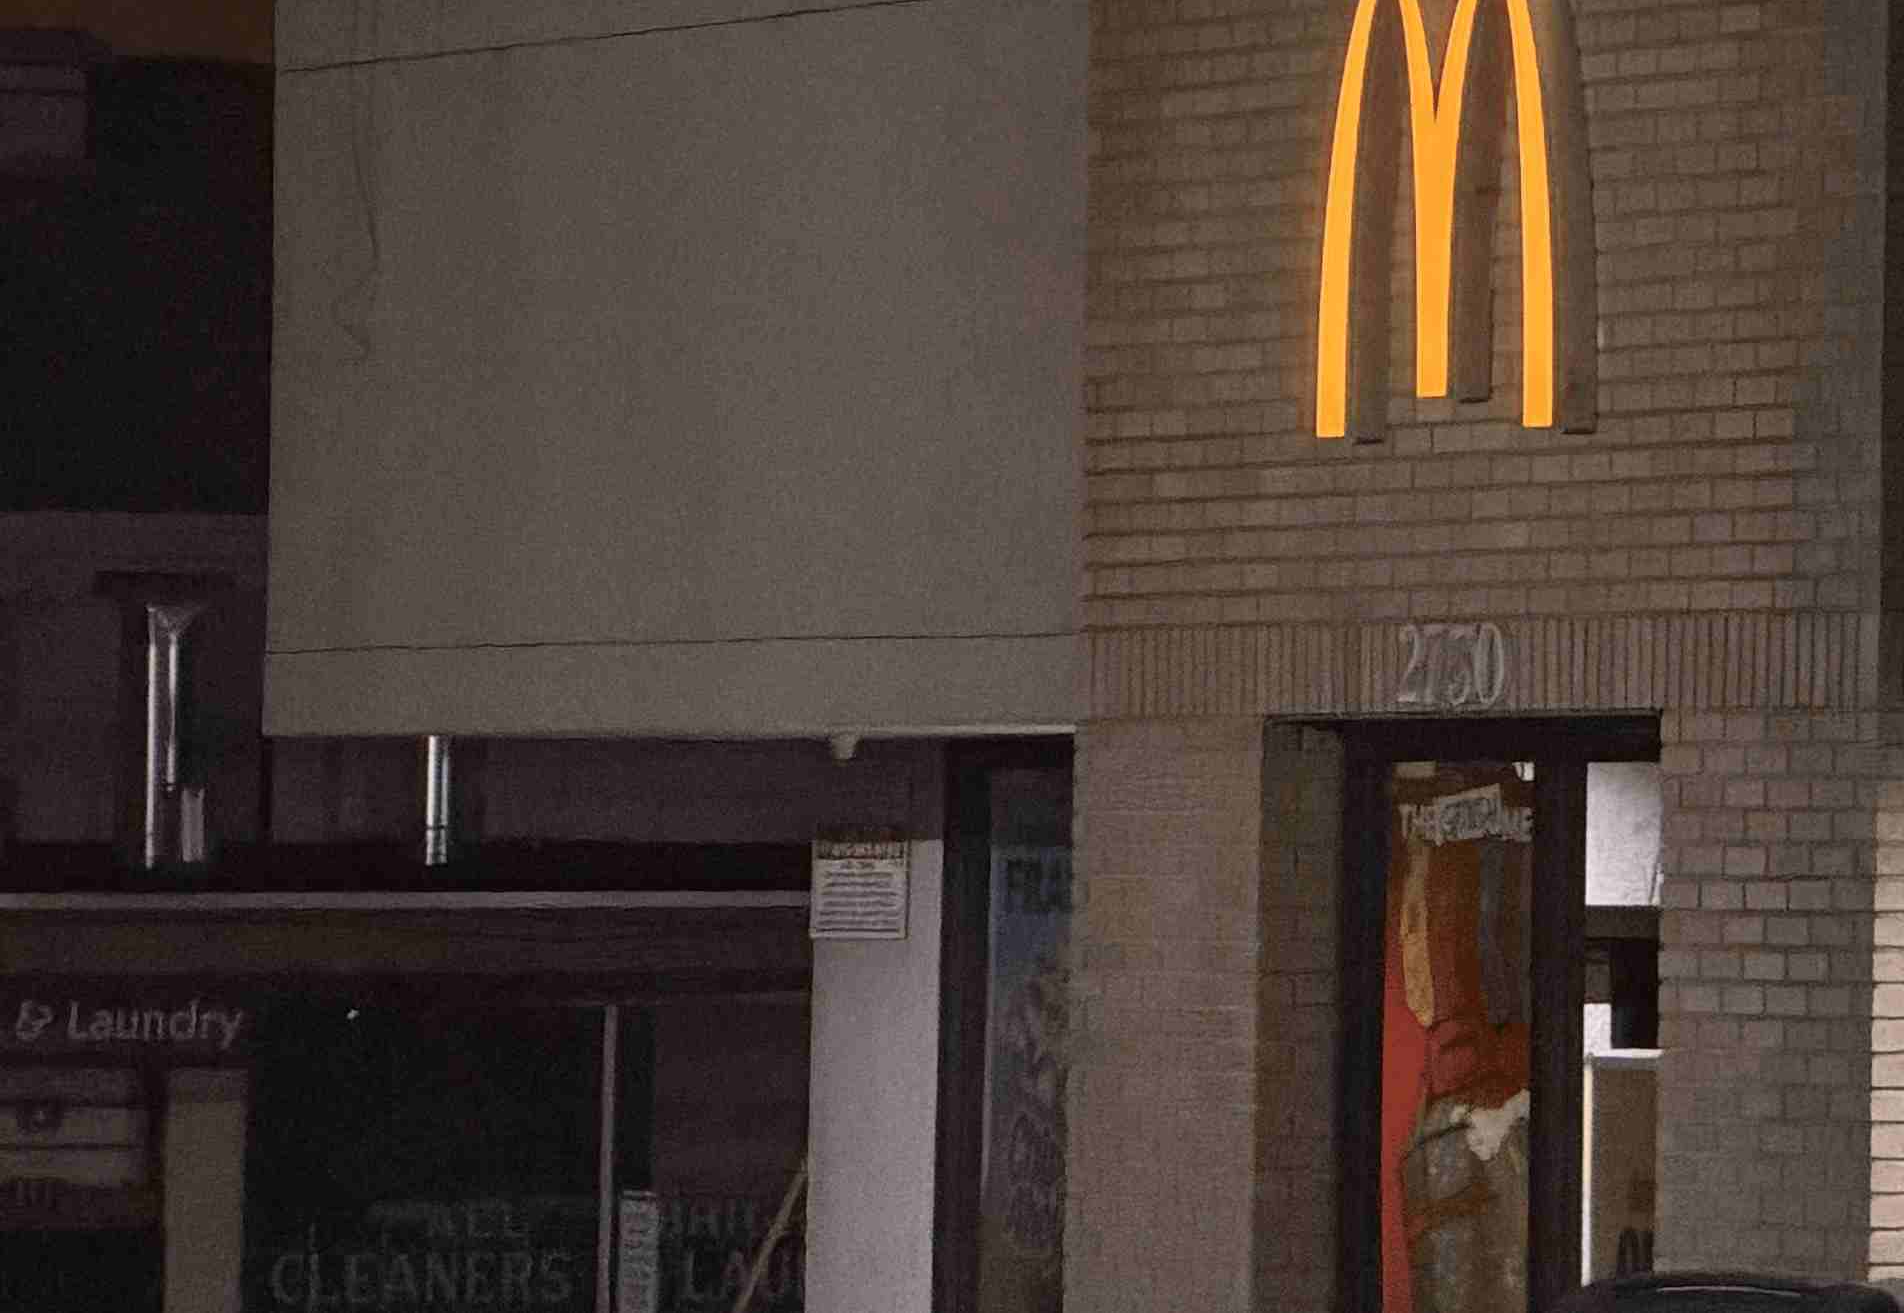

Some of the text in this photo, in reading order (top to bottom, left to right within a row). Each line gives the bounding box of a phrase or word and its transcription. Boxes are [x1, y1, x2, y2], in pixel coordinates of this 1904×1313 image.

[14, 996, 244, 1050] & Laundry
[271, 1251, 572, 1304] CLEANERS
